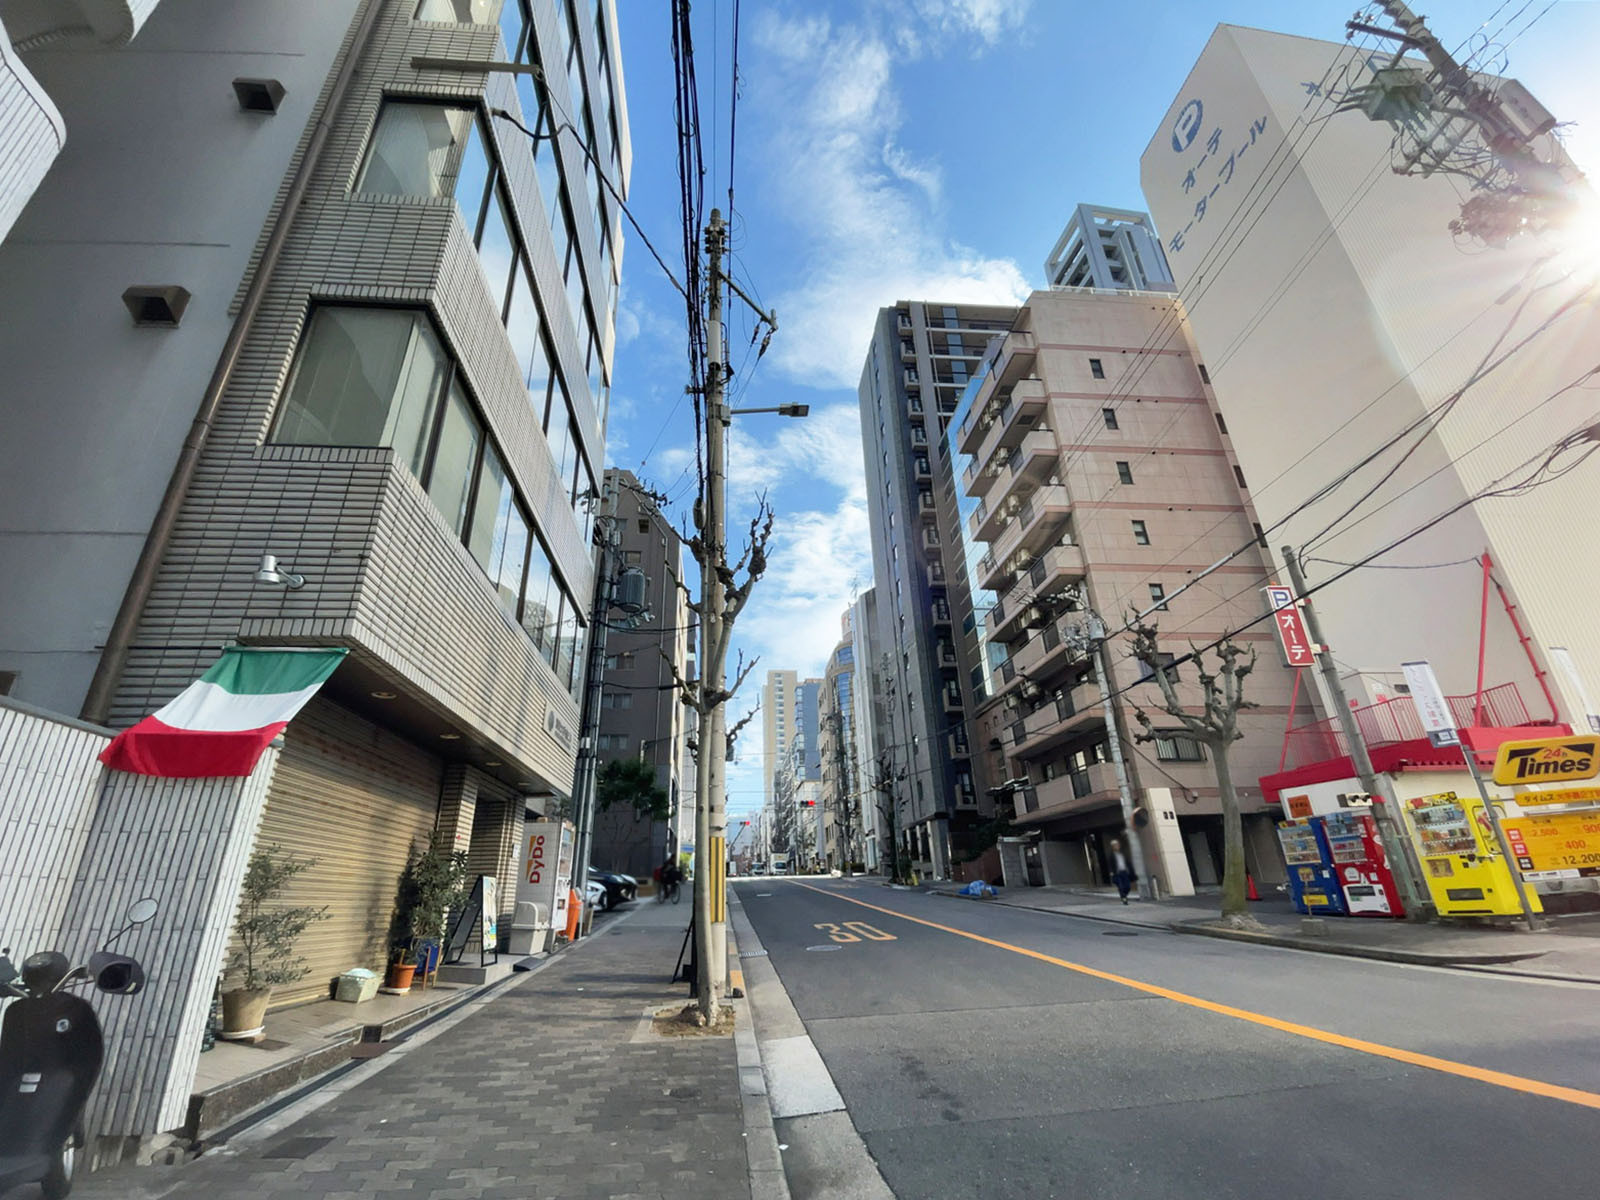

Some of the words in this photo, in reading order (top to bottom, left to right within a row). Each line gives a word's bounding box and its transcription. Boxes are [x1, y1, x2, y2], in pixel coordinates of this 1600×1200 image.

[1173, 101, 1201, 152] P
[1182, 127, 1222, 194] オーテ
[1271, 590, 1289, 608] P
[1281, 614, 1306, 661] オーテ
[1512, 752, 1592, 778] Times
[529, 835, 545, 884] DyDo
[1565, 840, 1586, 849] 400
[814, 921, 898, 943] 30
